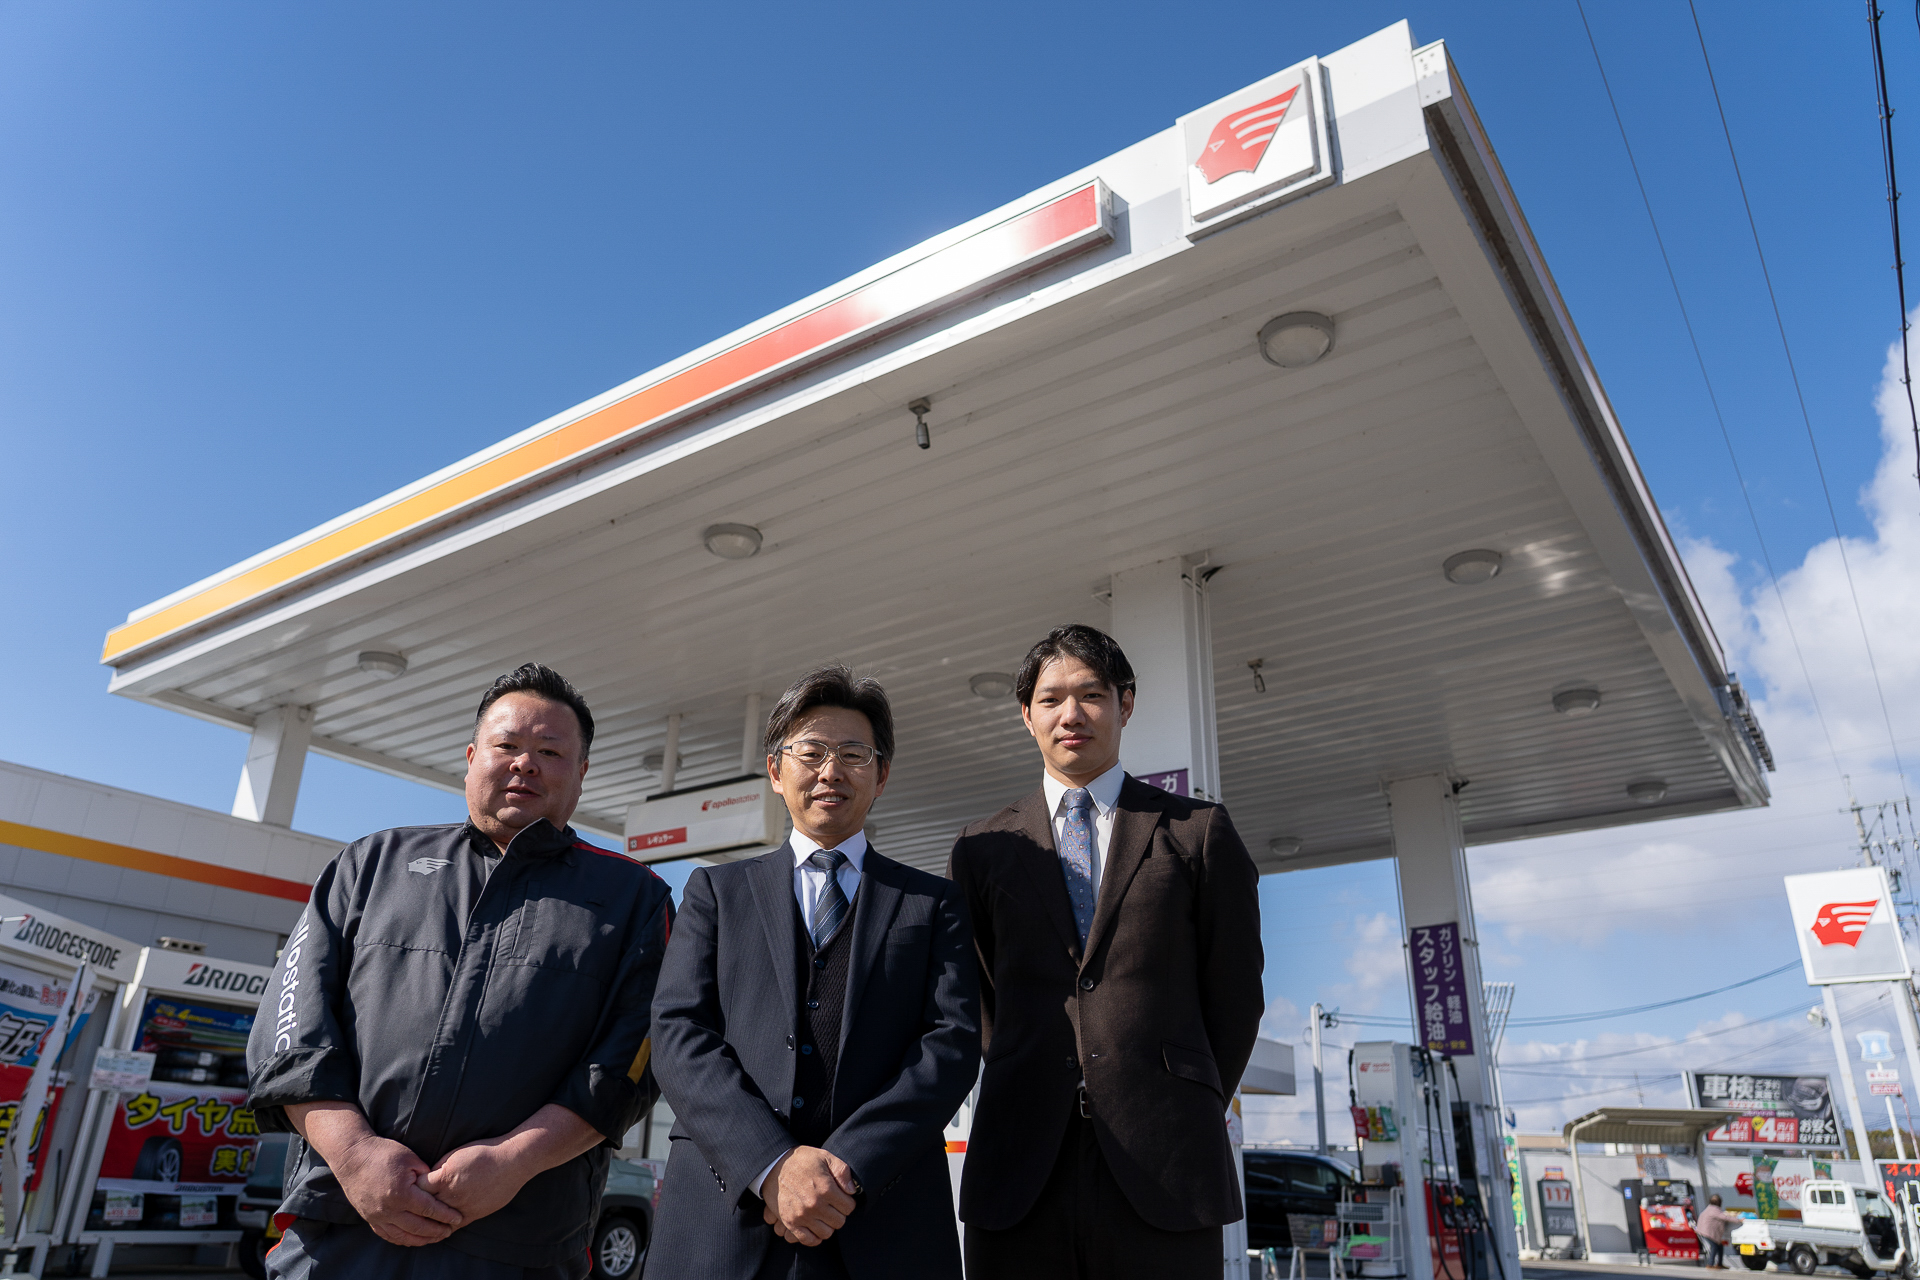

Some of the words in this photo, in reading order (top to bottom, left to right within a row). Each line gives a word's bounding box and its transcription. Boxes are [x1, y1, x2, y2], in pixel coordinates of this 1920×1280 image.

[711, 793, 761, 810] apollostation
[647, 834, 674, 846] レギュラー
[14, 914, 122, 970] BRIDGESTONE
[183, 963, 270, 997] BRIDG
[1416, 928, 1447, 1042] スタッフ給油
[1701, 1075, 1755, 1100] 車検
[1757, 1117, 1777, 1142] 4
[1545, 1186, 1571, 1202] 117
